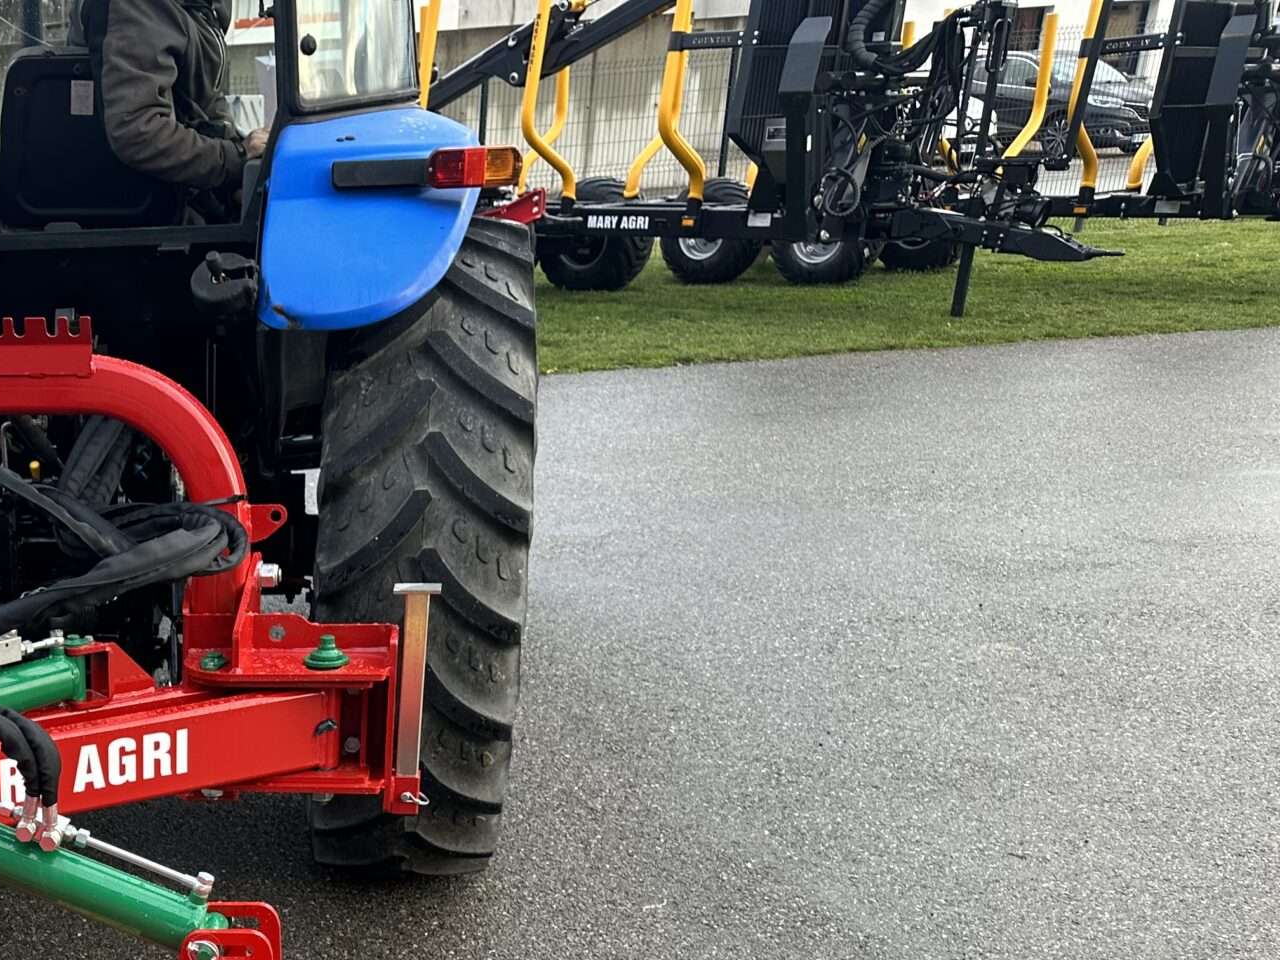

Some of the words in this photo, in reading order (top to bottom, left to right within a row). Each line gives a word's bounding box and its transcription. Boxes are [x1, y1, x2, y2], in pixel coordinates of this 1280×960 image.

[587, 214, 618, 229] MARY
[620, 215, 650, 230] AGRI
[72, 728, 189, 793] AGRI
